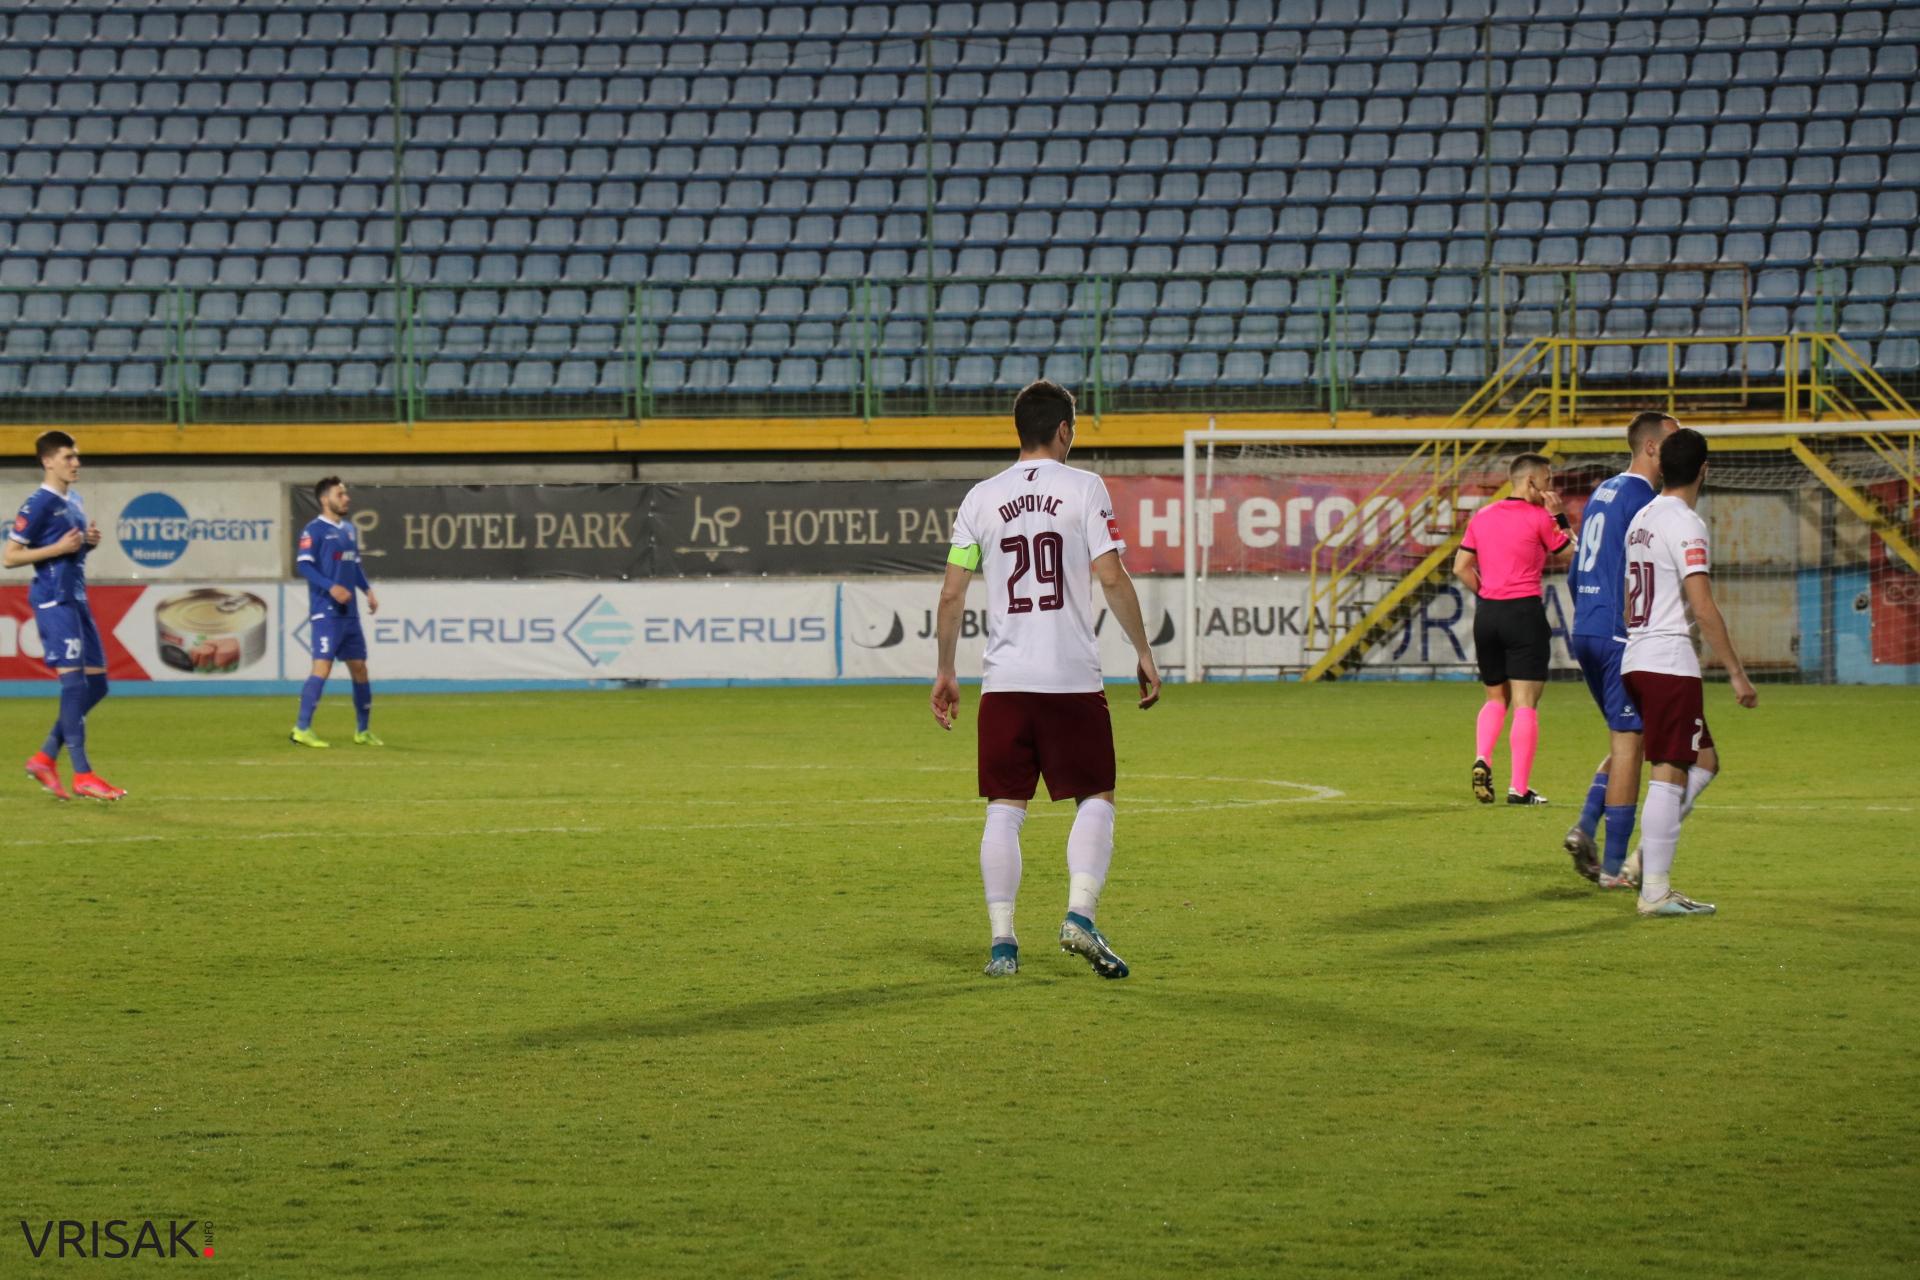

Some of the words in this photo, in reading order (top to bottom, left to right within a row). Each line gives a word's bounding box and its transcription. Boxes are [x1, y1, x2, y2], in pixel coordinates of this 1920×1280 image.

[998, 494, 1063, 523] DUPOVAC
[403, 514, 526, 550] HOTEL
[534, 512, 632, 549] PARK
[766, 509, 889, 546] HOTEL
[1578, 512, 1605, 573] 19
[132, 548, 176, 561] Mostar
[1000, 531, 1064, 614] 29
[1629, 561, 1655, 628] 21
[375, 618, 555, 643] EMERUS
[644, 617, 826, 643] EMERUS
